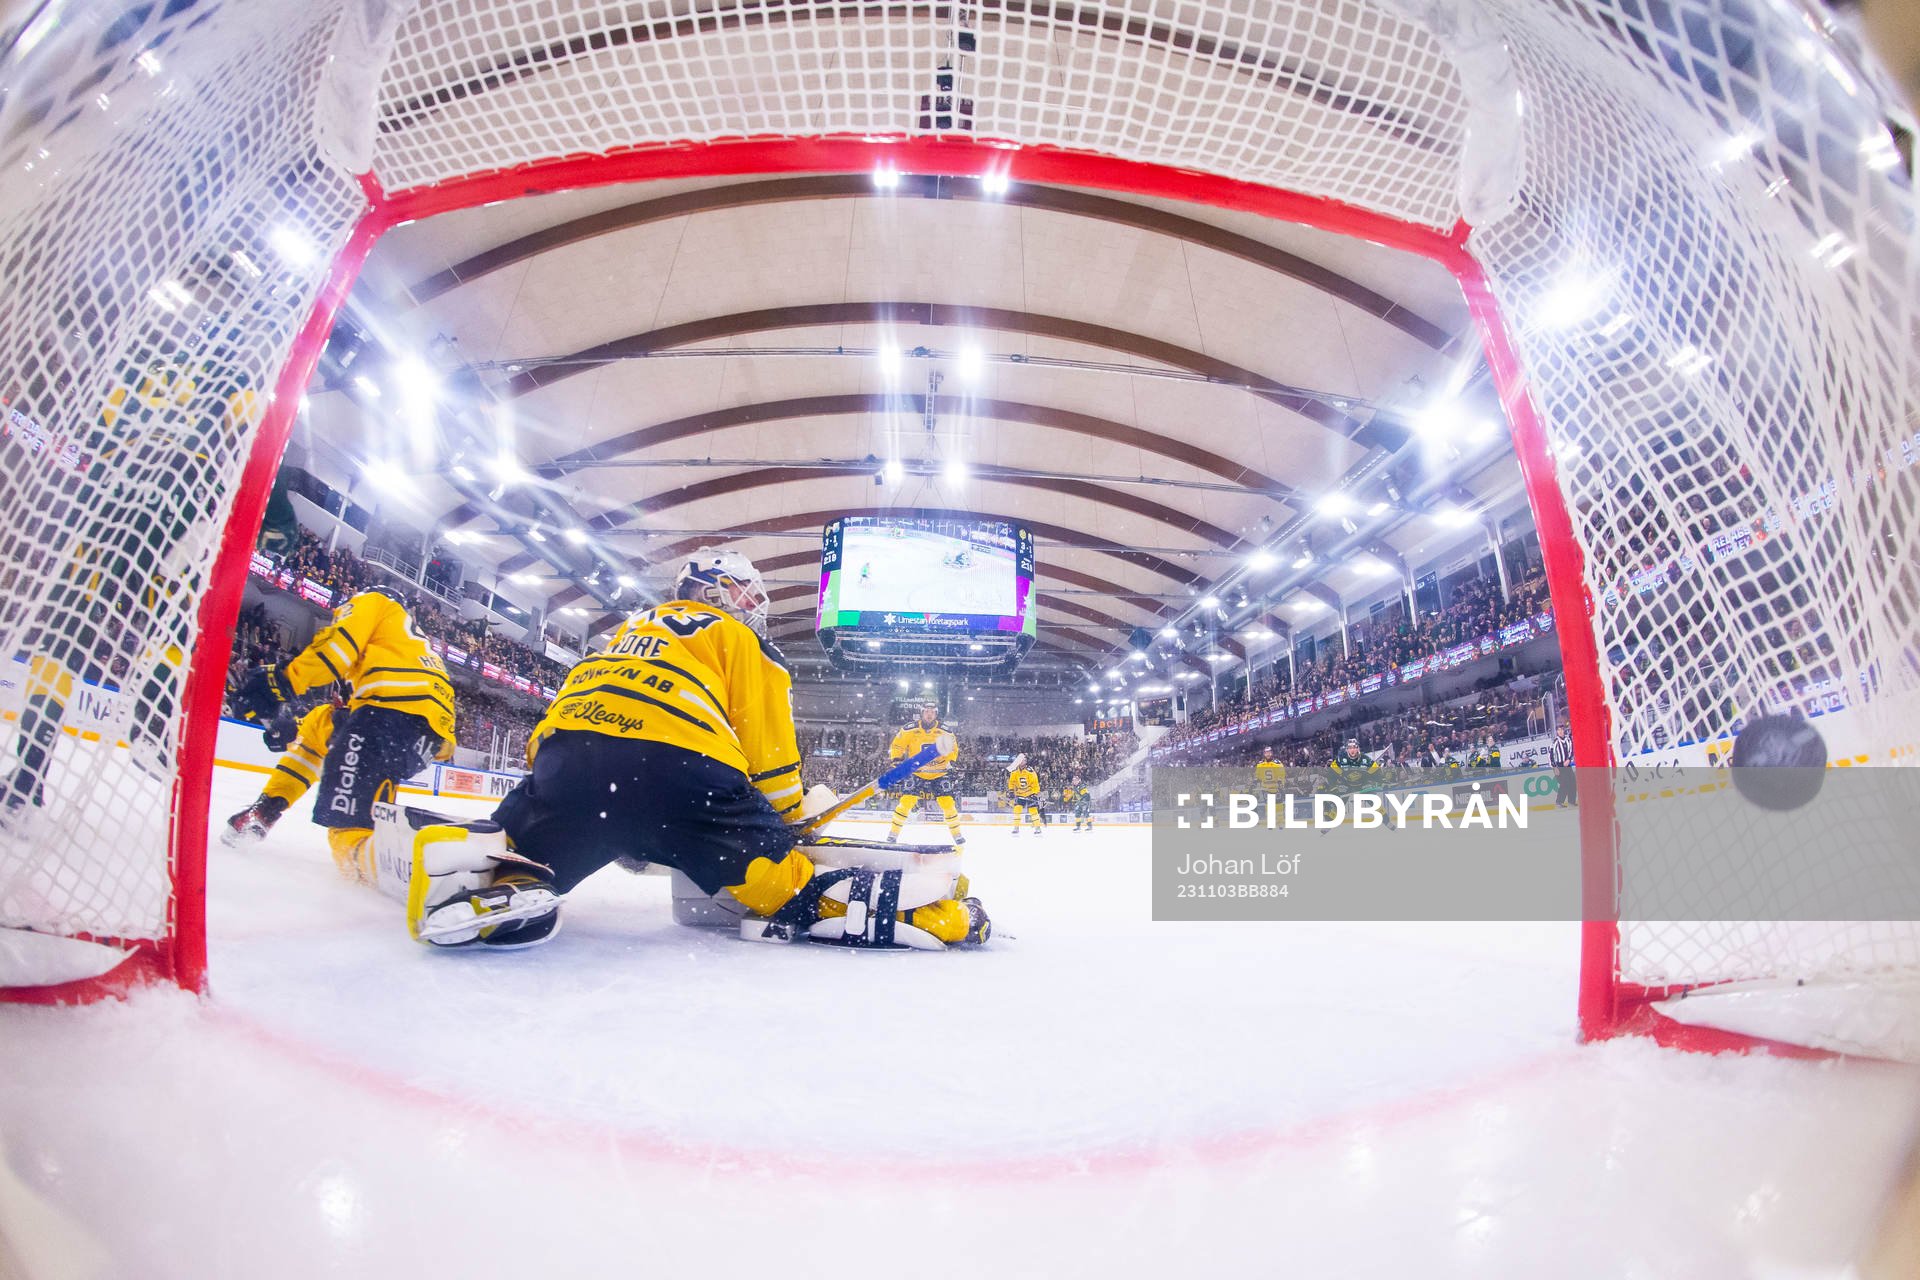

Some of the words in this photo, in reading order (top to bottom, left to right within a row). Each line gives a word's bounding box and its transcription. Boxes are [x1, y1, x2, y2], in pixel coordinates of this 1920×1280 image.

[642, 674, 675, 694] AB
[1018, 777, 1028, 788] S
[373, 804, 398, 825] CCM
